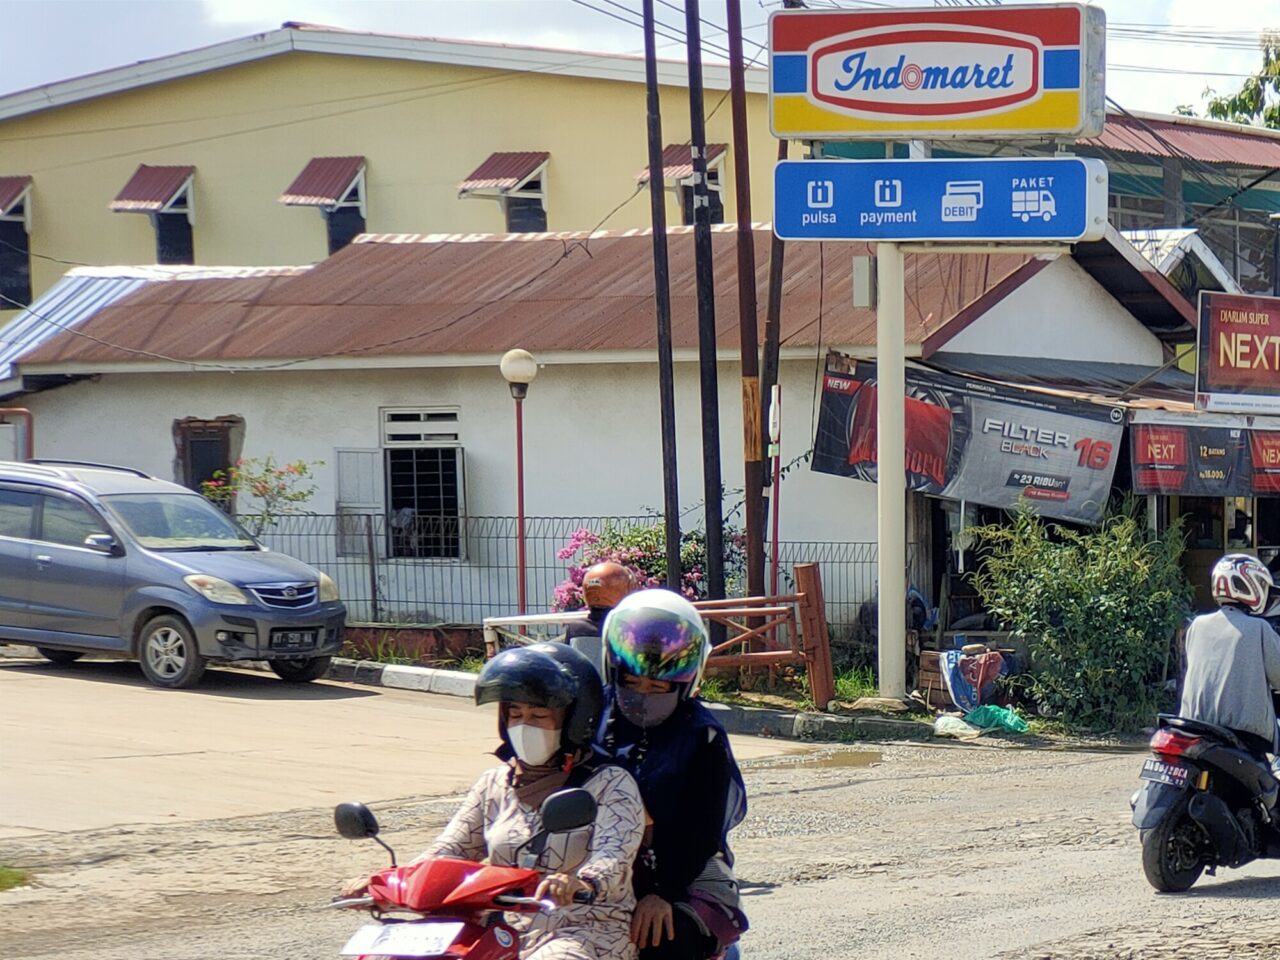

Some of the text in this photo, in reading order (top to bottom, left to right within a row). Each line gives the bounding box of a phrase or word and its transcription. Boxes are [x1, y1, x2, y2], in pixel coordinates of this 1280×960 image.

[834, 51, 1014, 91] Indomaret
[1012, 176, 1055, 188] PAKET
[802, 210, 837, 226] pulsa
[860, 209, 918, 226] payment
[943, 205, 975, 217] DEBIT
[1220, 309, 1270, 326] DJARUM SUPER
[827, 378, 851, 390] NEW
[983, 417, 1071, 448] FILTER
[1001, 440, 1049, 459] BLACK
[1074, 437, 1113, 470] 16
[1147, 443, 1176, 460] NEXT
[1200, 446, 1208, 457] 12
[1020, 474, 1032, 484] 23
